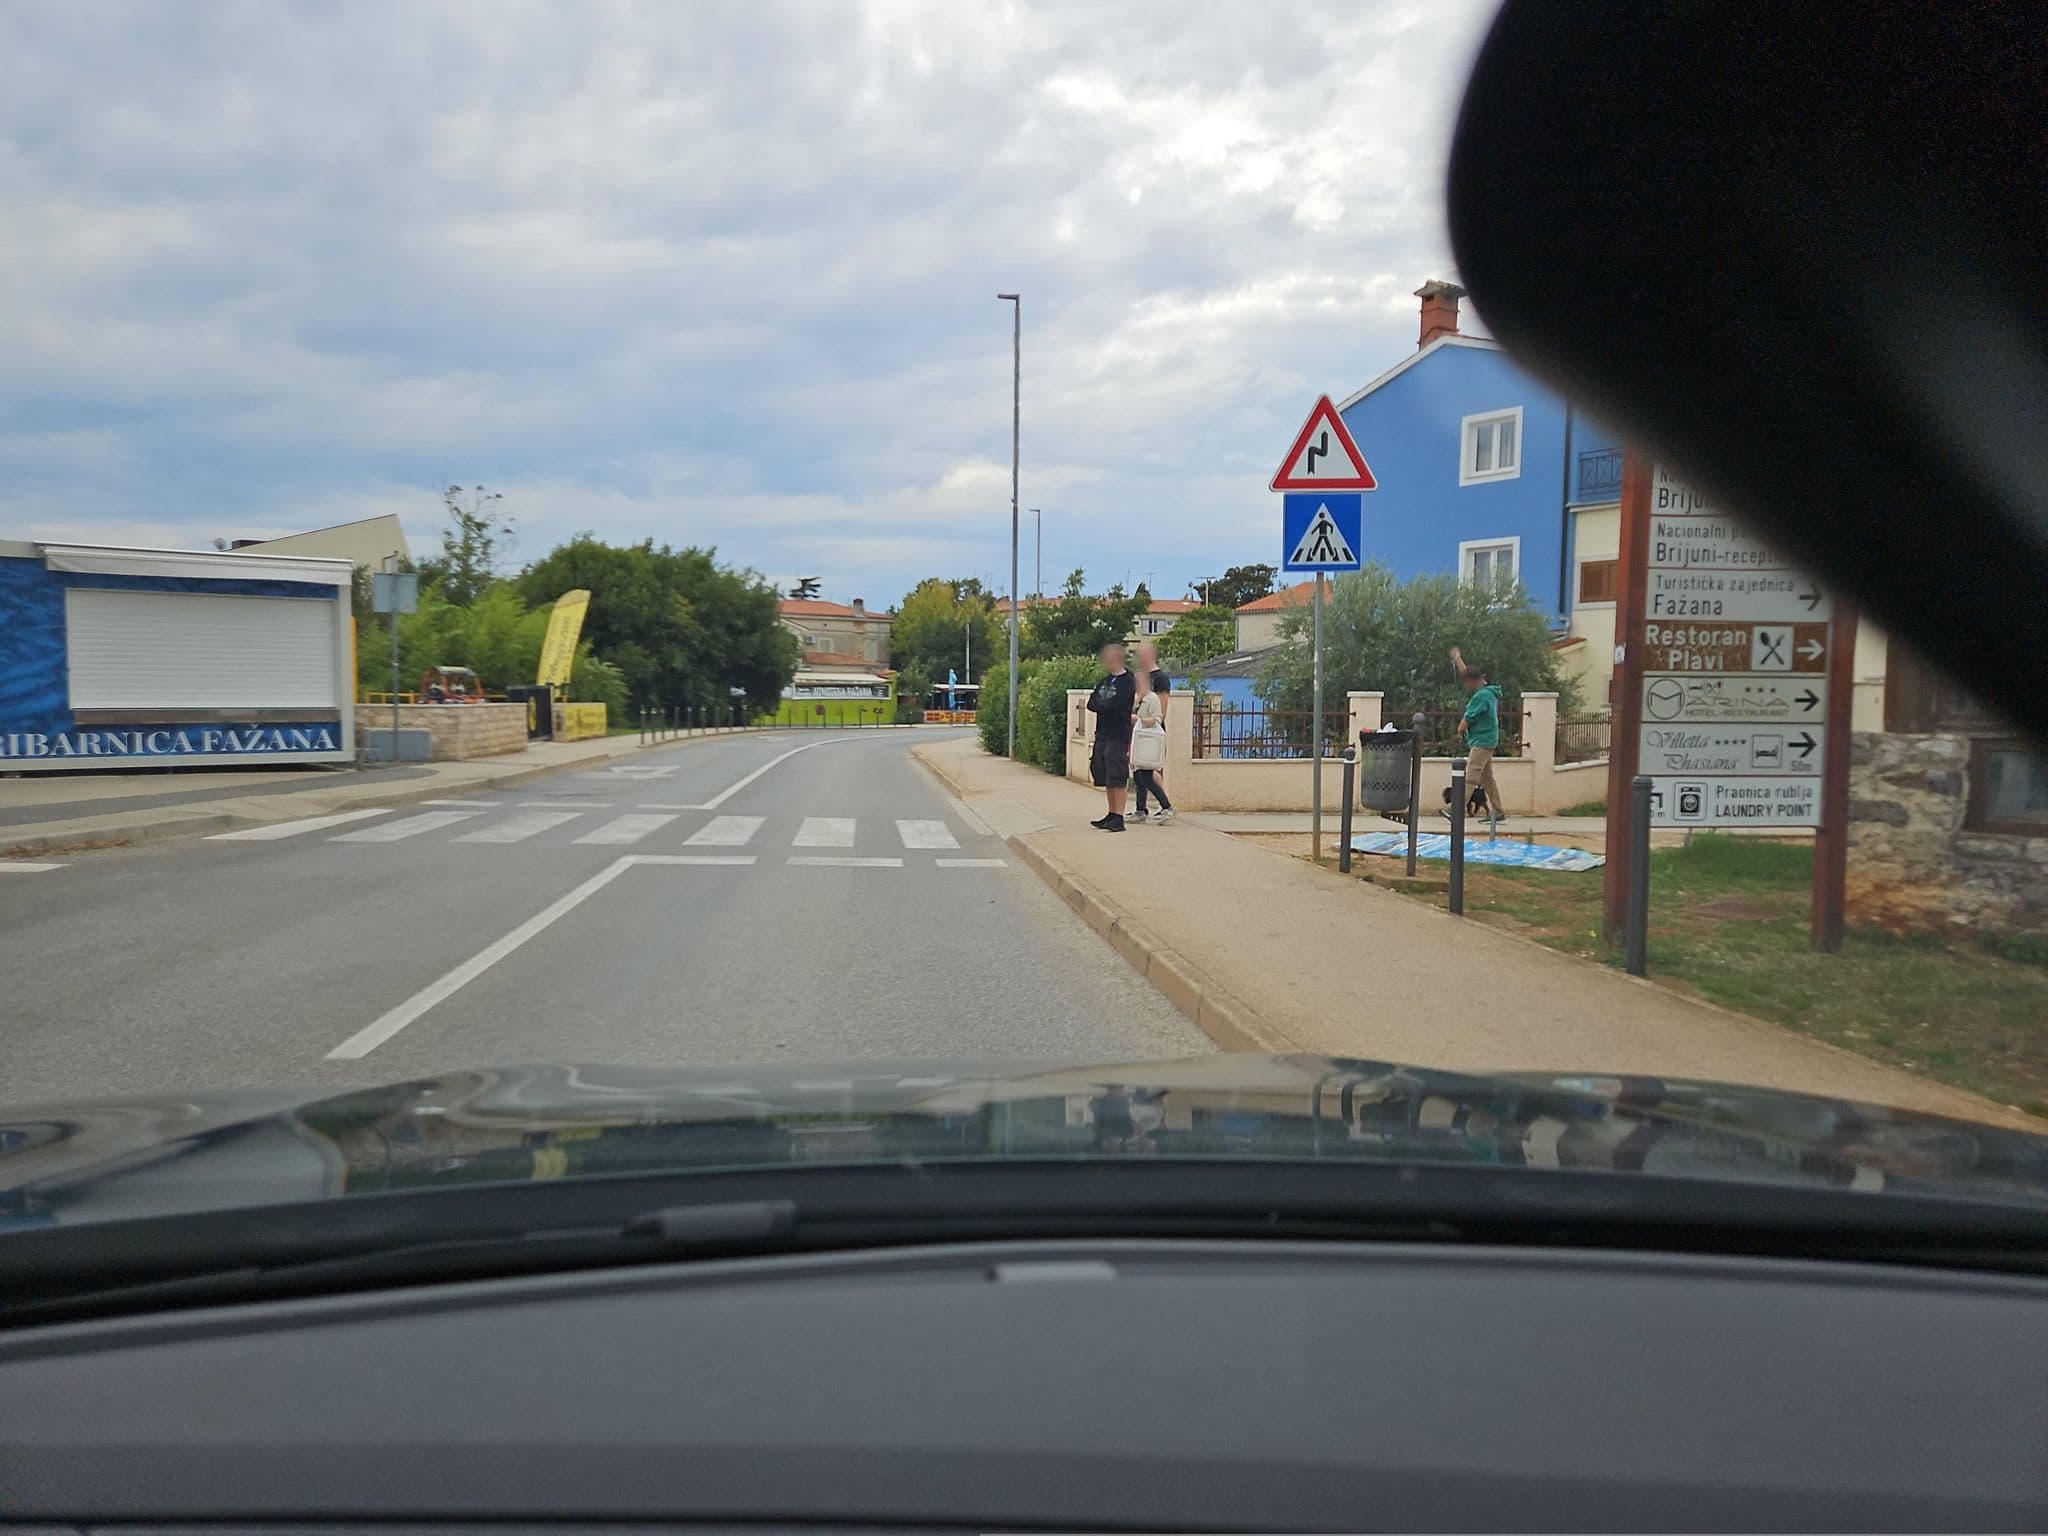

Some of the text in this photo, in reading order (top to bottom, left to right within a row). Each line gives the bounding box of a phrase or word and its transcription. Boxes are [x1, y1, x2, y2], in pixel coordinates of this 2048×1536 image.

[1657, 522, 1727, 538] Nacionalni
[1656, 574, 1794, 595] Turistička zajednica
[1645, 624, 1747, 646] Restoran
[1669, 650, 1724, 671] Plavi
[0, 724, 337, 757] IBARNICA FAŽANA
[1716, 785, 1813, 800] Praonica rublja
[1716, 803, 1813, 818] LAUNDRY POINT
